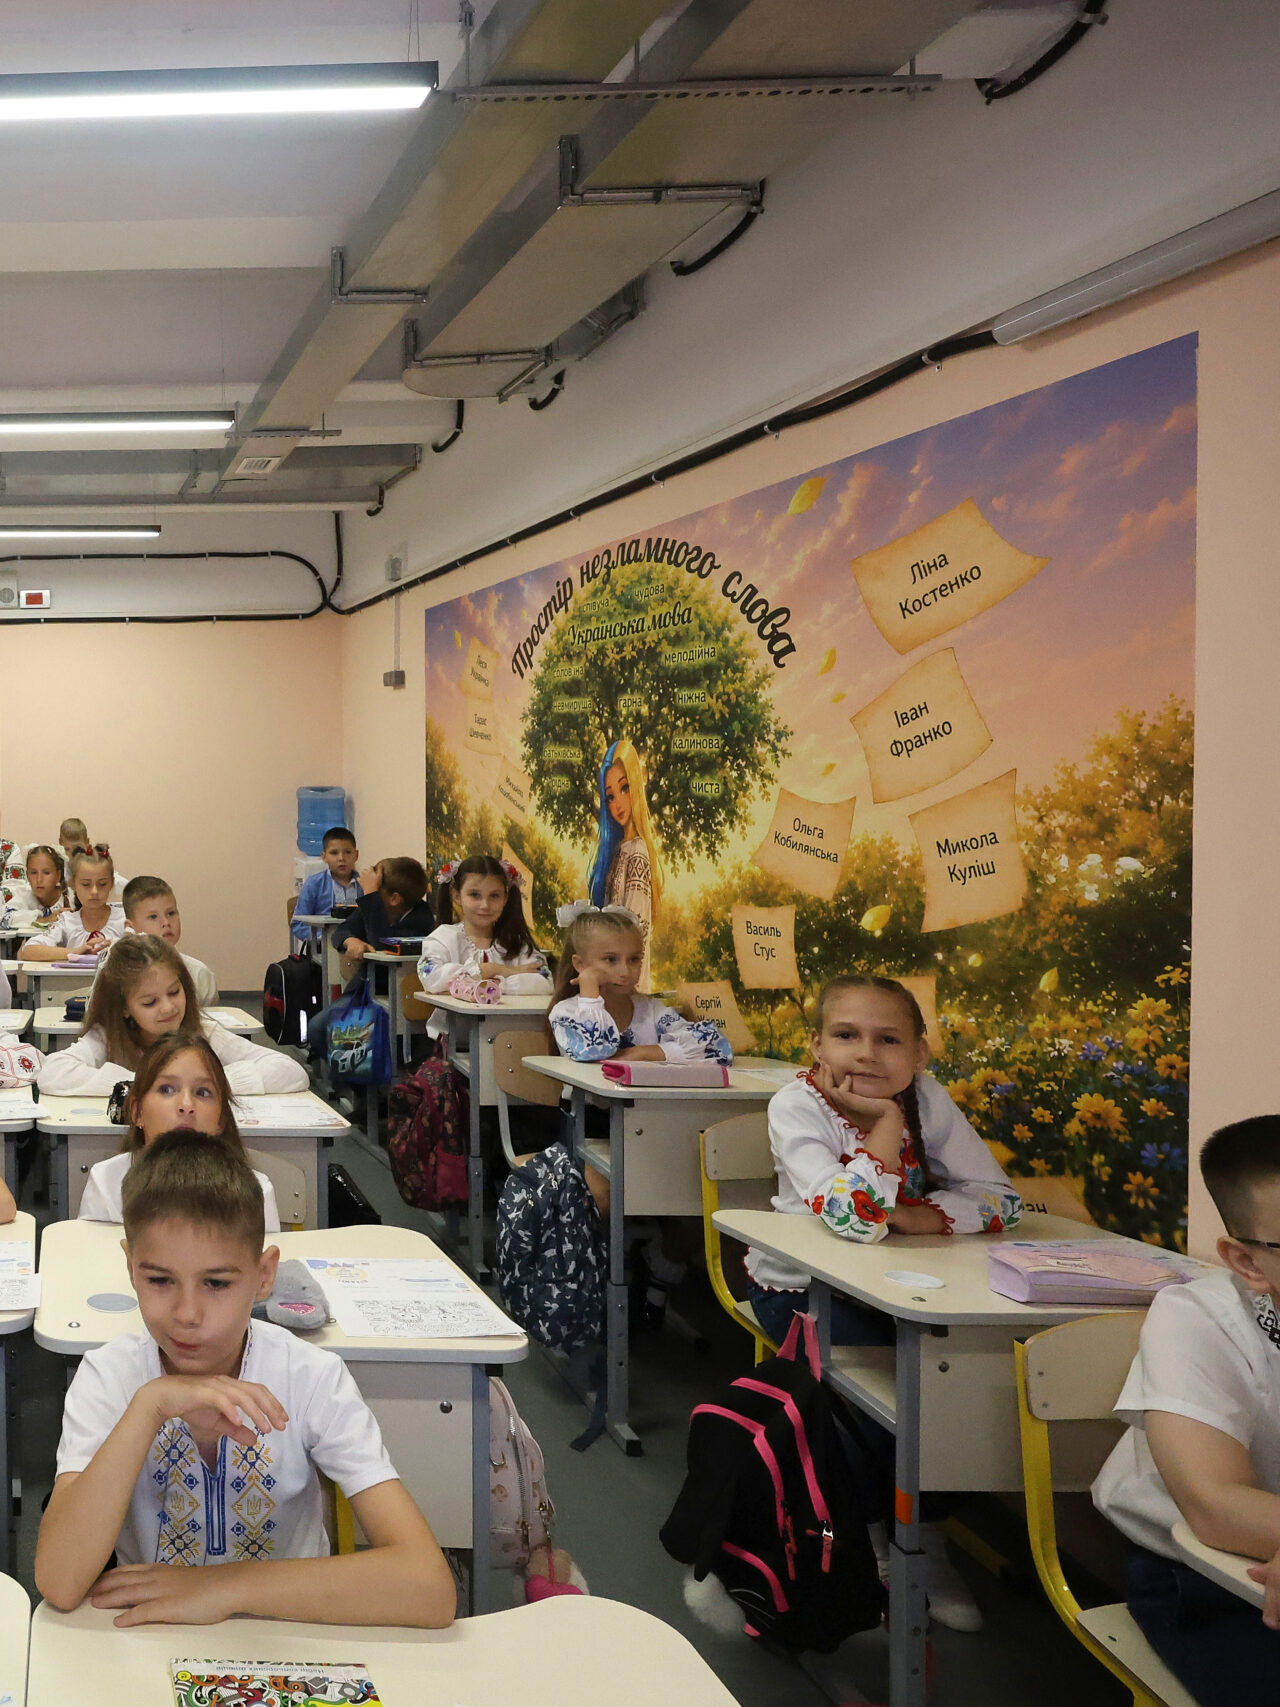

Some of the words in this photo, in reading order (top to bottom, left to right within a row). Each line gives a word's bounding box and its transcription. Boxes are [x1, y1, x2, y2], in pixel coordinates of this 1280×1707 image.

[910, 553, 949, 585] Ліна
[634, 583, 665, 602] чудова
[898, 565, 982, 620] Костенко
[511, 576, 574, 680] Простір
[580, 537, 722, 587] незламного
[721, 570, 797, 669] слова
[582, 597, 610, 613] співуча
[568, 616, 646, 649] Українська
[647, 600, 693, 632] мова
[664, 645, 716, 664] мелодійна
[676, 689, 706, 704] ніжна
[894, 701, 930, 728] Іван
[672, 737, 720, 749] калинова
[889, 720, 953, 758] Франко
[690, 782, 720, 794] чиста
[792, 817, 824, 839] Ольга
[773, 831, 839, 863] Кобилянська
[935, 831, 1000, 858] Микола
[947, 859, 996, 886] Куліш
[745, 920, 782, 938] Василь
[753, 942, 776, 961] Стус
[695, 994, 722, 1012] Сергій
